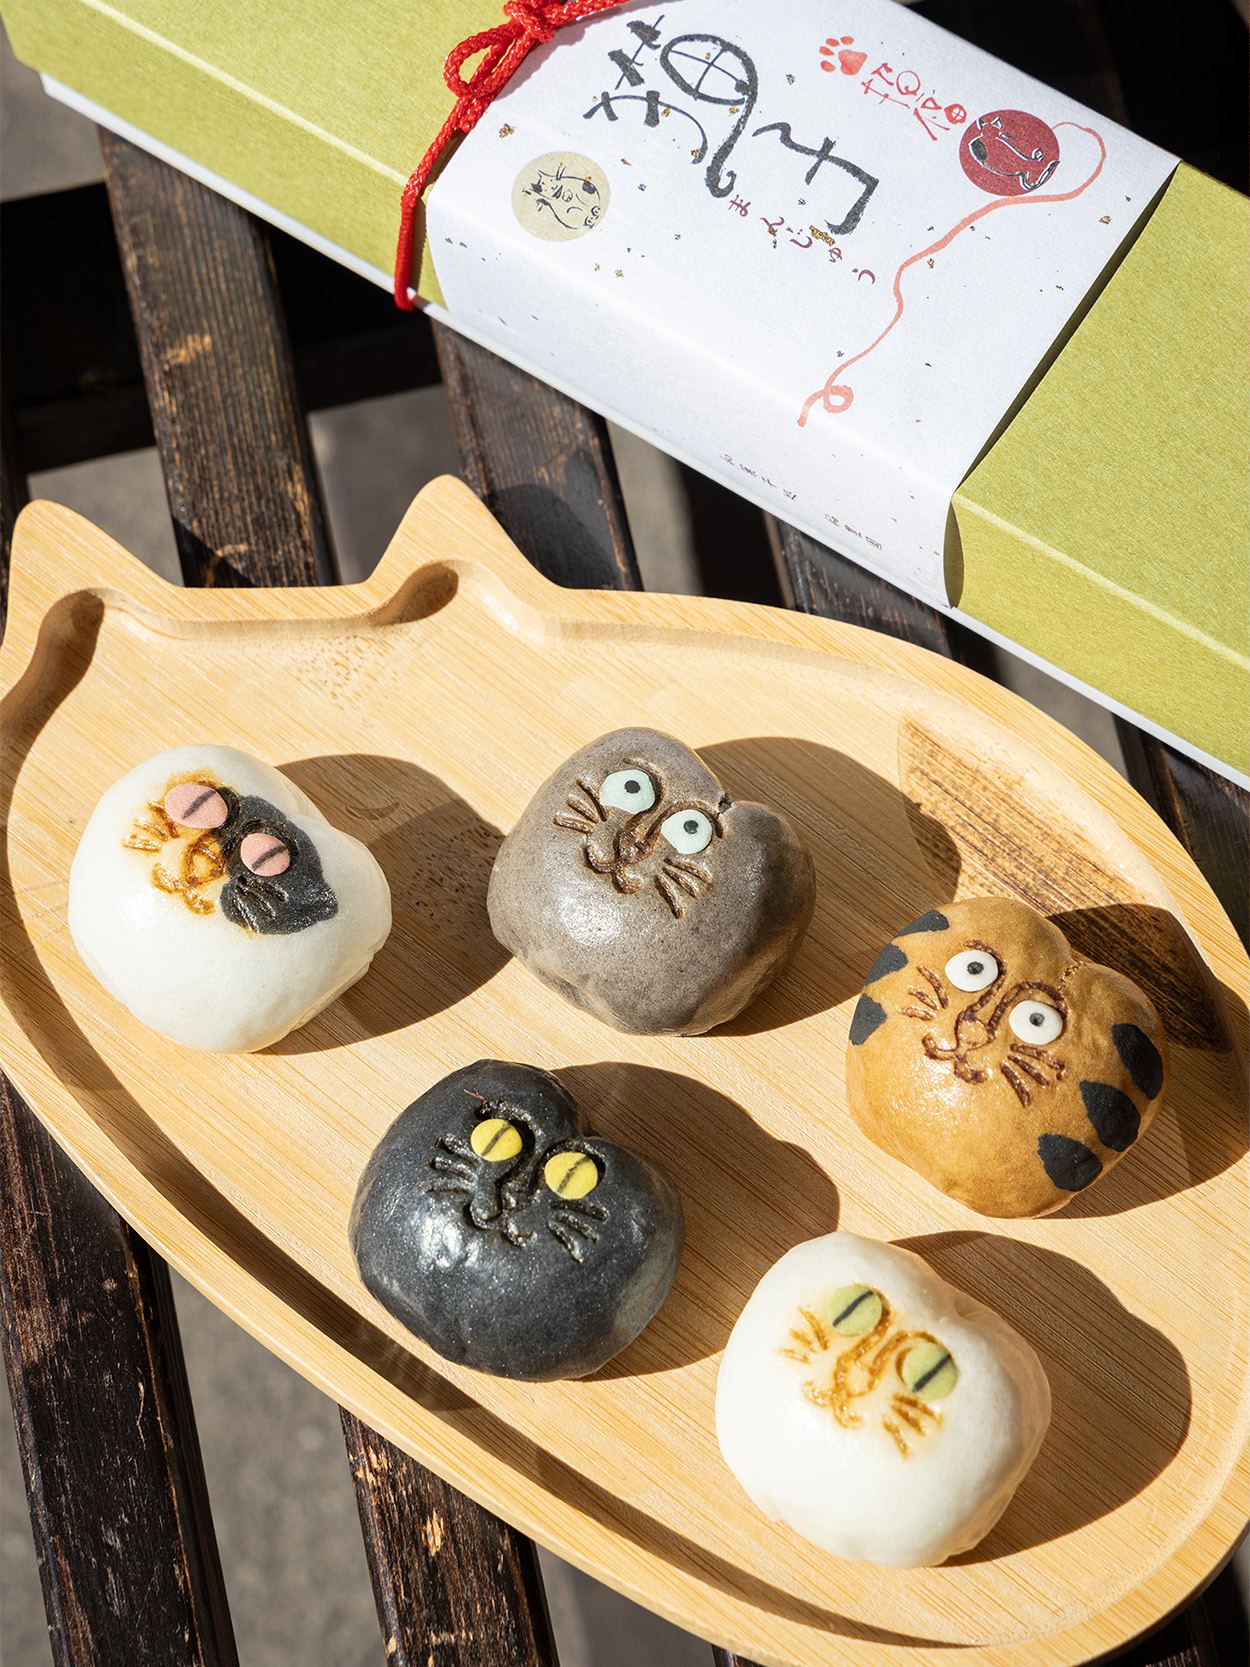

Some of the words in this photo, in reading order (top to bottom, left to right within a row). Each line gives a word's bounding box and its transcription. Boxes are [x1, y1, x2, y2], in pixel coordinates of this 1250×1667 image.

[861, 62, 967, 141] 招福
[727, 194, 876, 286] まんじゅう
